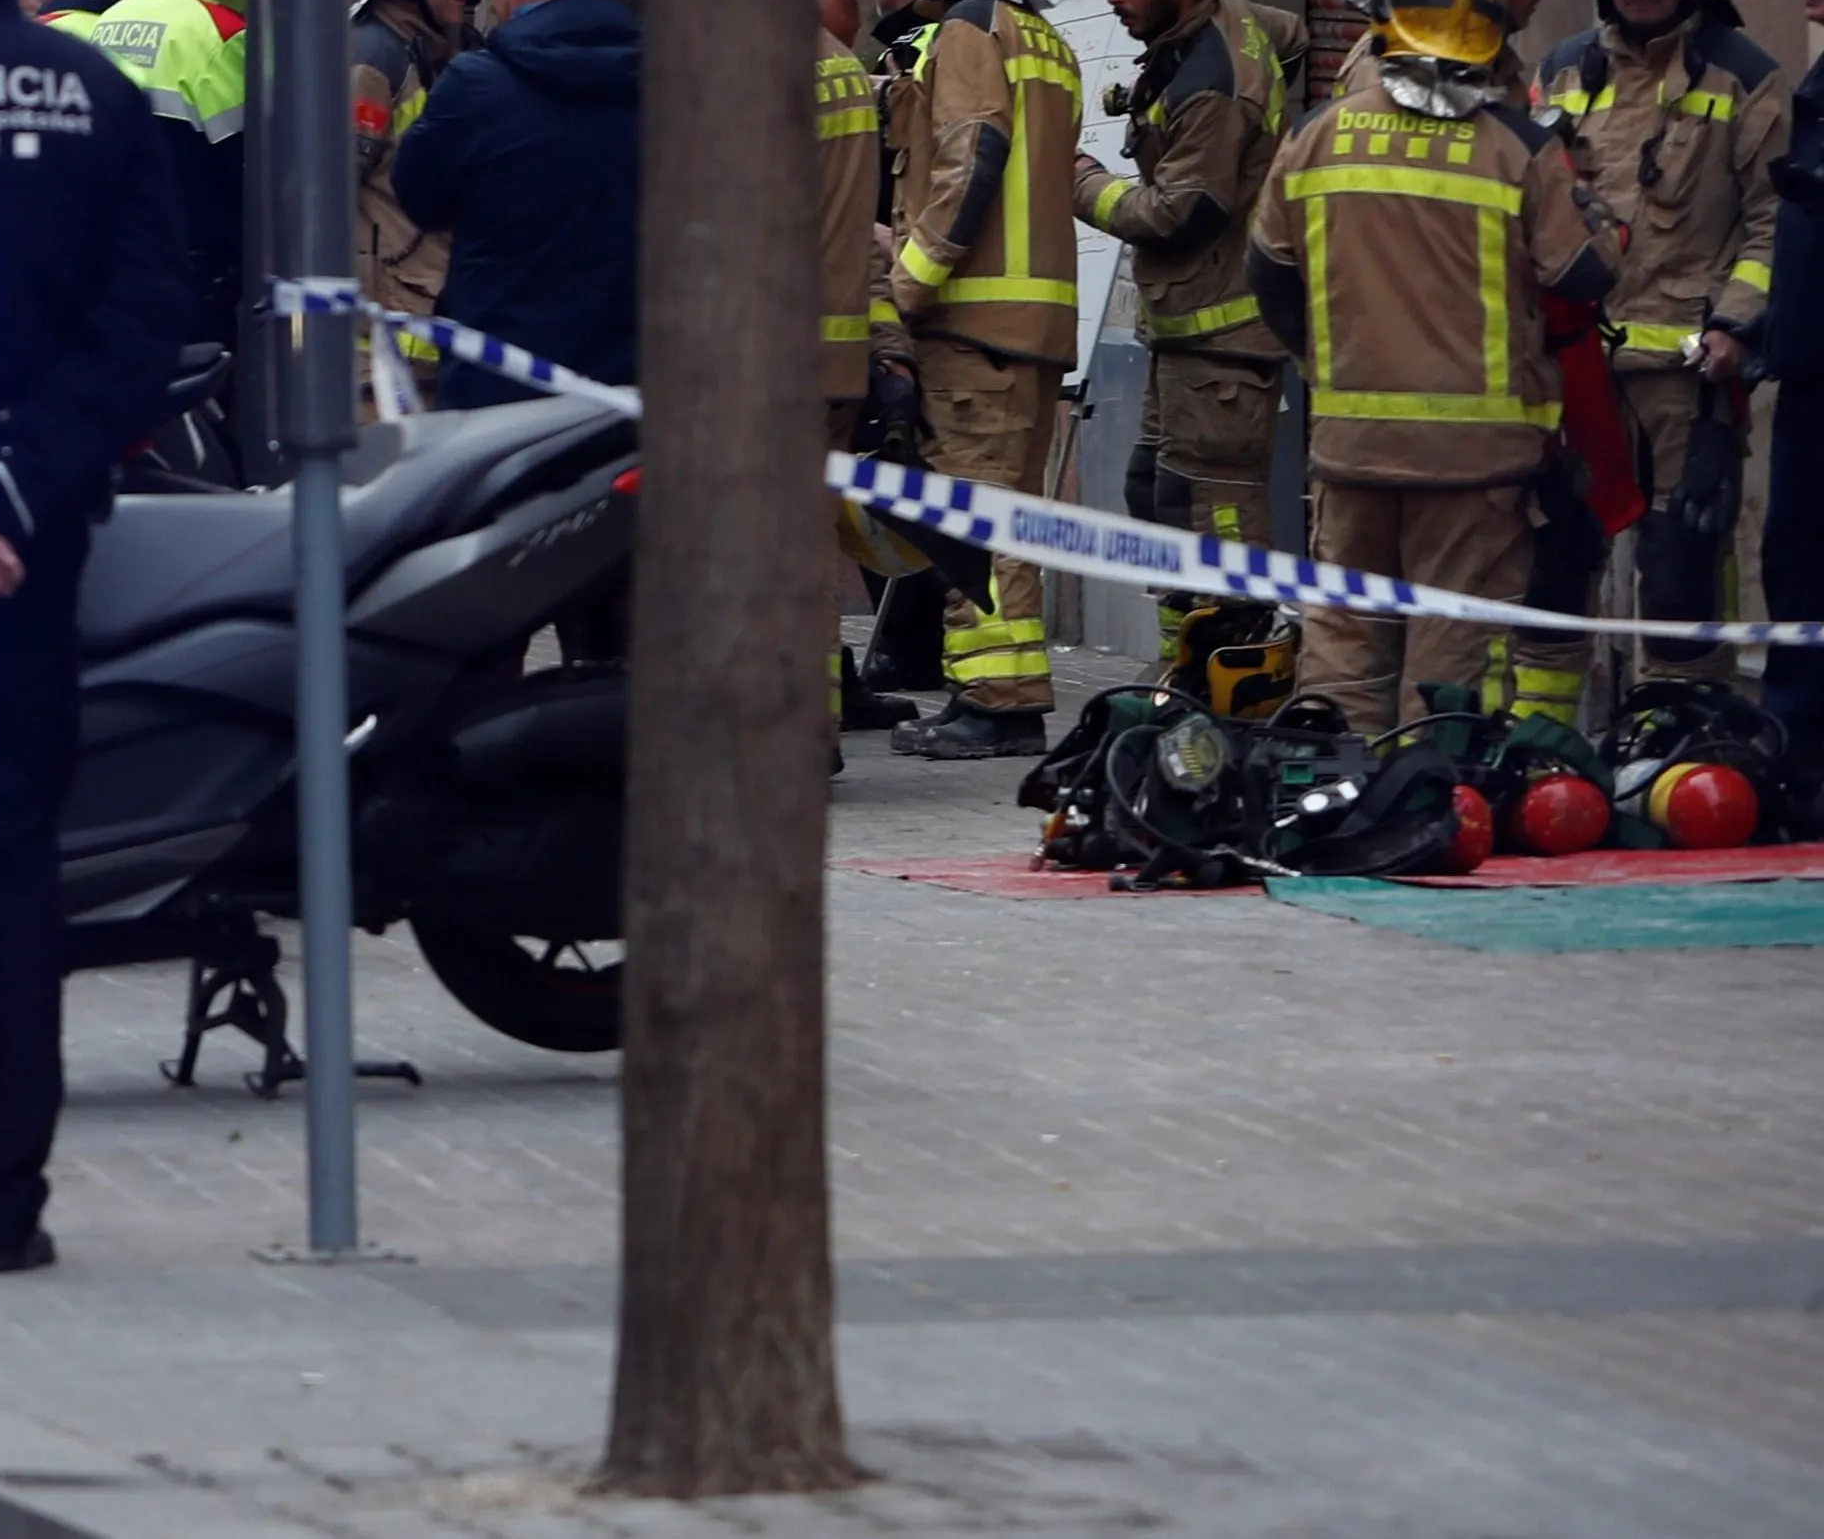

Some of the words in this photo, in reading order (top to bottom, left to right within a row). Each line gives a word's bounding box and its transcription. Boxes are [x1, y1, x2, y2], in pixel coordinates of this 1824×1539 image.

[90, 23, 159, 49] POLICIA
[1336, 107, 1476, 140] bombers
[1011, 506, 1098, 558] GUARDIA
[1102, 528, 1181, 574] URBANA
